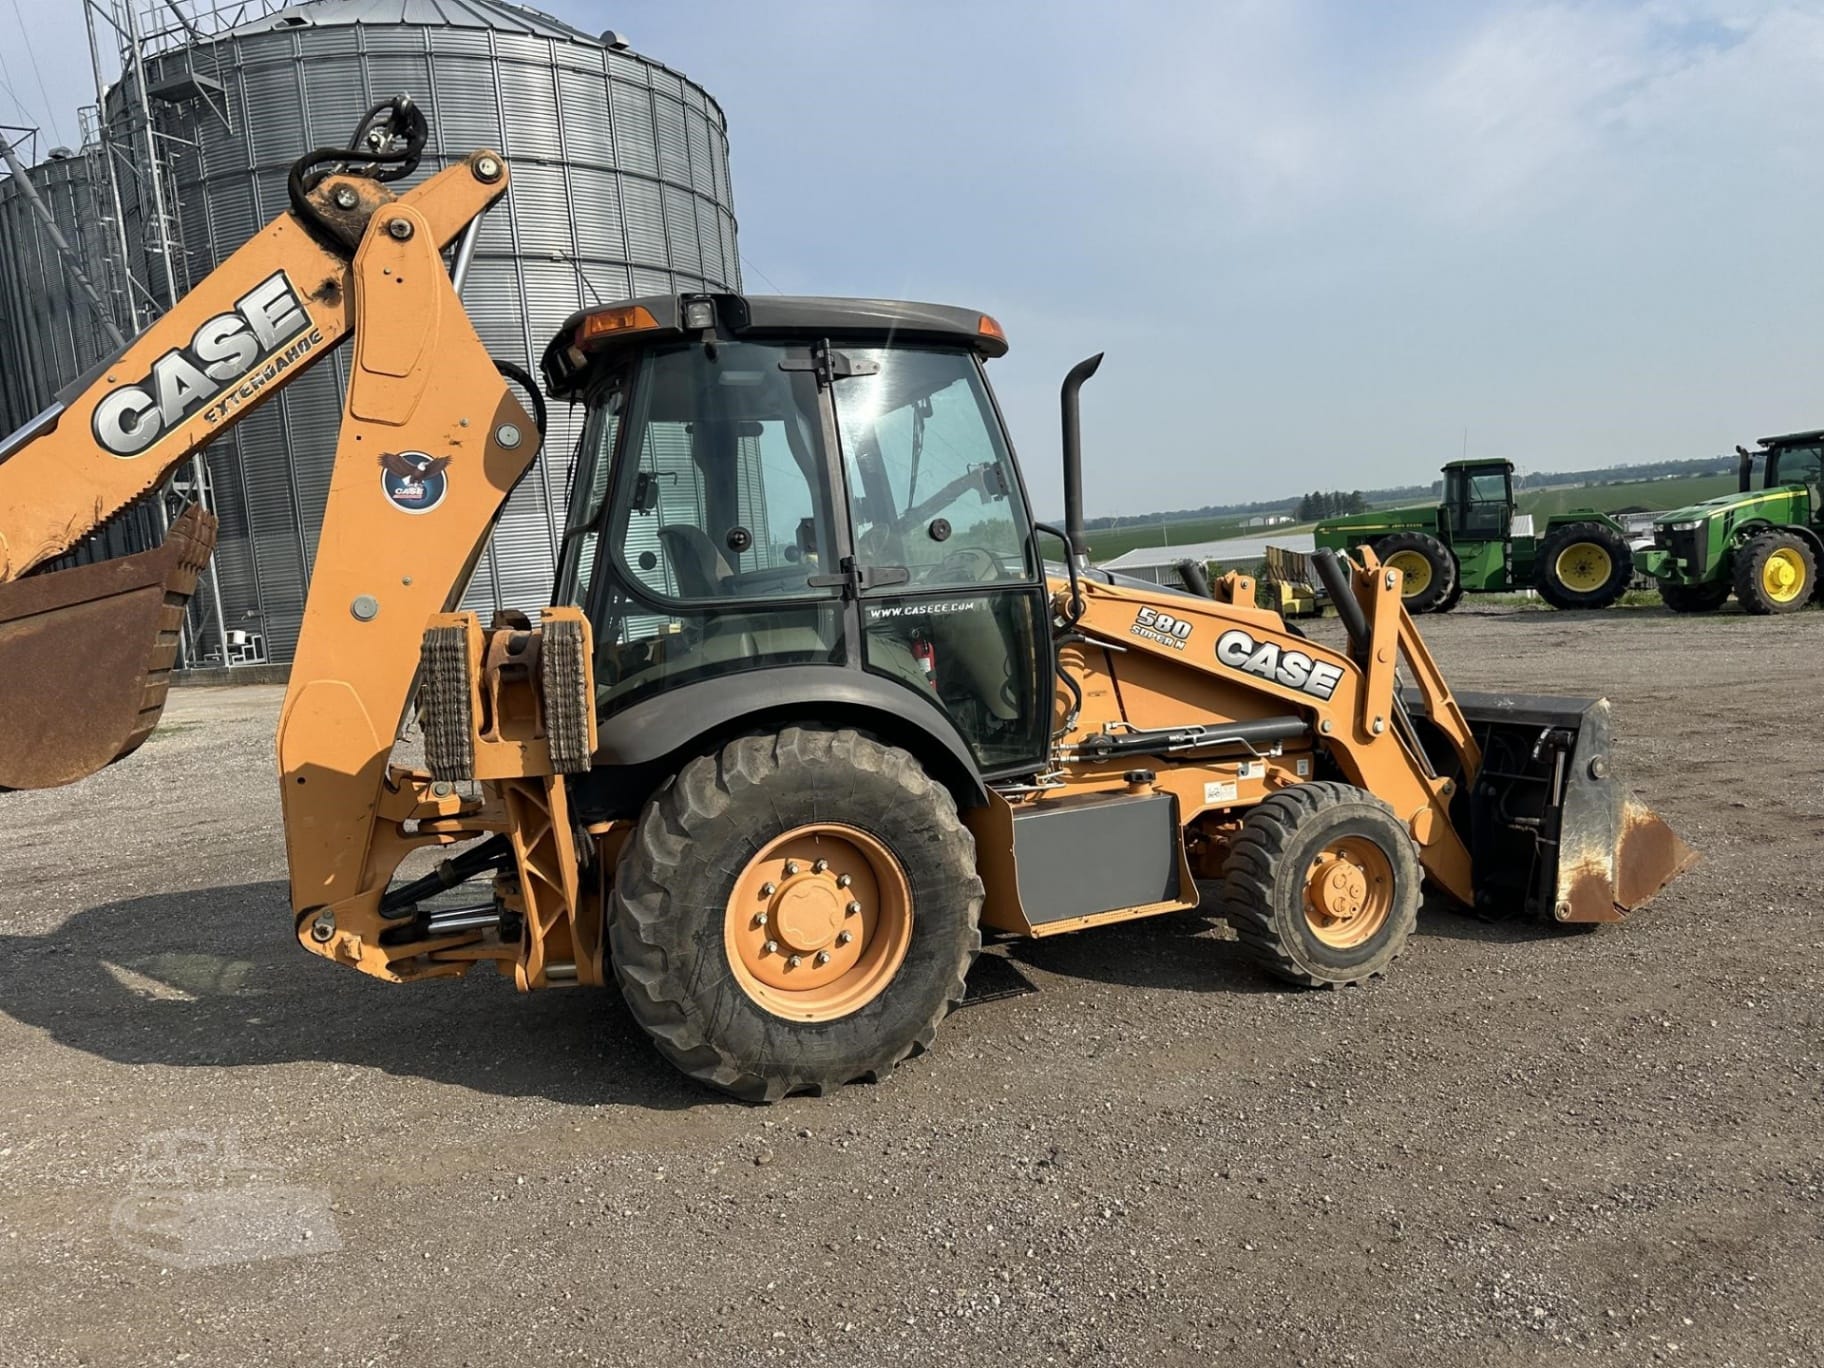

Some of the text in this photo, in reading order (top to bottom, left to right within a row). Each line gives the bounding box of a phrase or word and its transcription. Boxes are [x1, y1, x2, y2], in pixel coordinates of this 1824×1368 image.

[92, 271, 309, 453] CASE
[1130, 624, 1186, 650] SUPER N
[1136, 606, 1193, 639] 580
[1216, 629, 1345, 700] CASE
